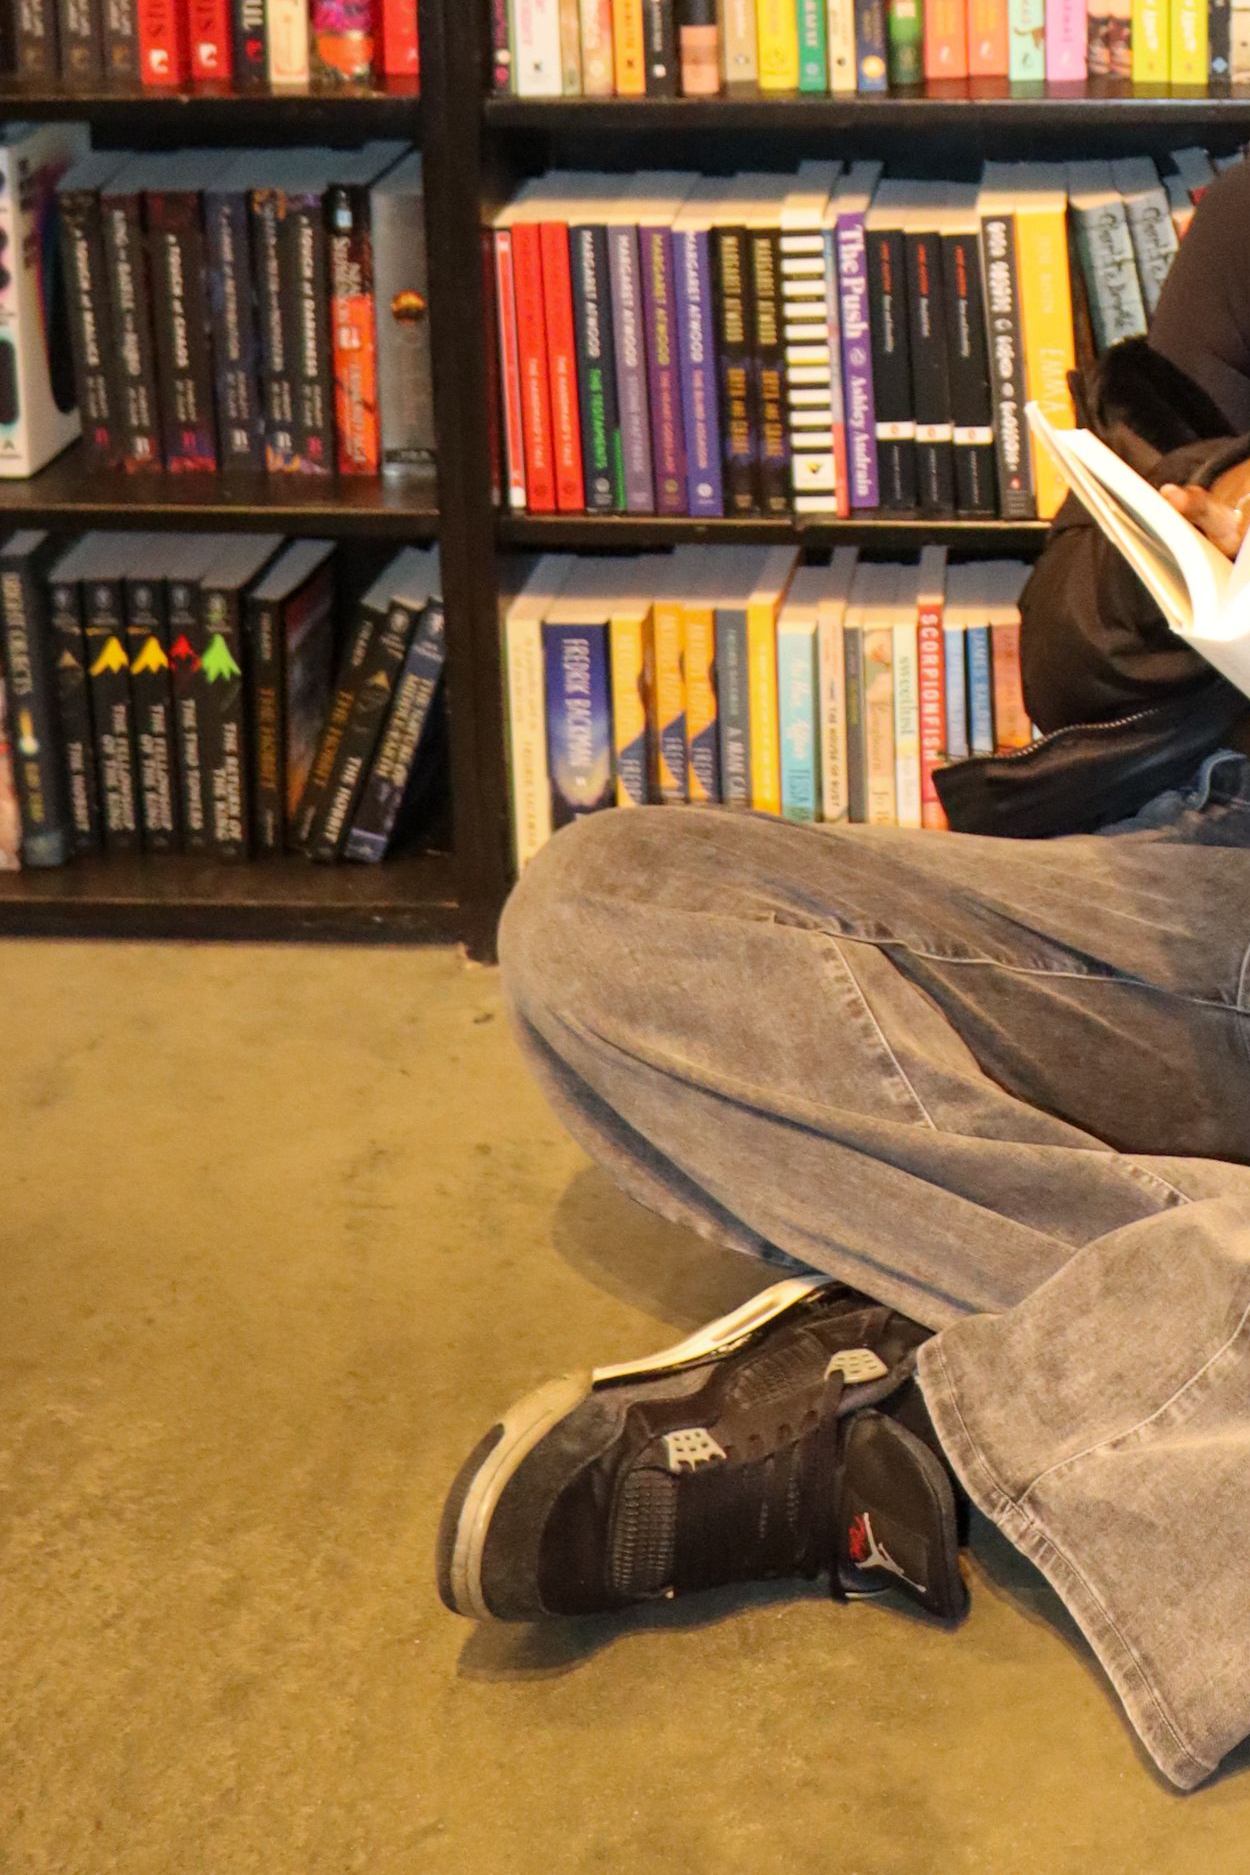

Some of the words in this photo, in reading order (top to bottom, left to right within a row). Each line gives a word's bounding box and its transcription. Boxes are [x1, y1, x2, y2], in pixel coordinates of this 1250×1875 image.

[581, 230, 597, 299] MARGARET
[618, 234, 634, 307] MARGARET
[684, 230, 700, 302] MARGARET
[839, 224, 863, 273] The
[586, 301, 601, 358] ATWOOD
[623, 309, 638, 367] ATWOOD
[688, 304, 703, 362] ATWOOD
[840, 276, 868, 339] Push
[849, 375, 871, 429] Ashley
[1039, 348, 1066, 414] EMMA
[853, 431, 872, 496] Audrain
[562, 638, 590, 696] FREDRIK
[921, 613, 943, 761] SCORPIONFISH
[566, 698, 593, 767] BACKMAN
